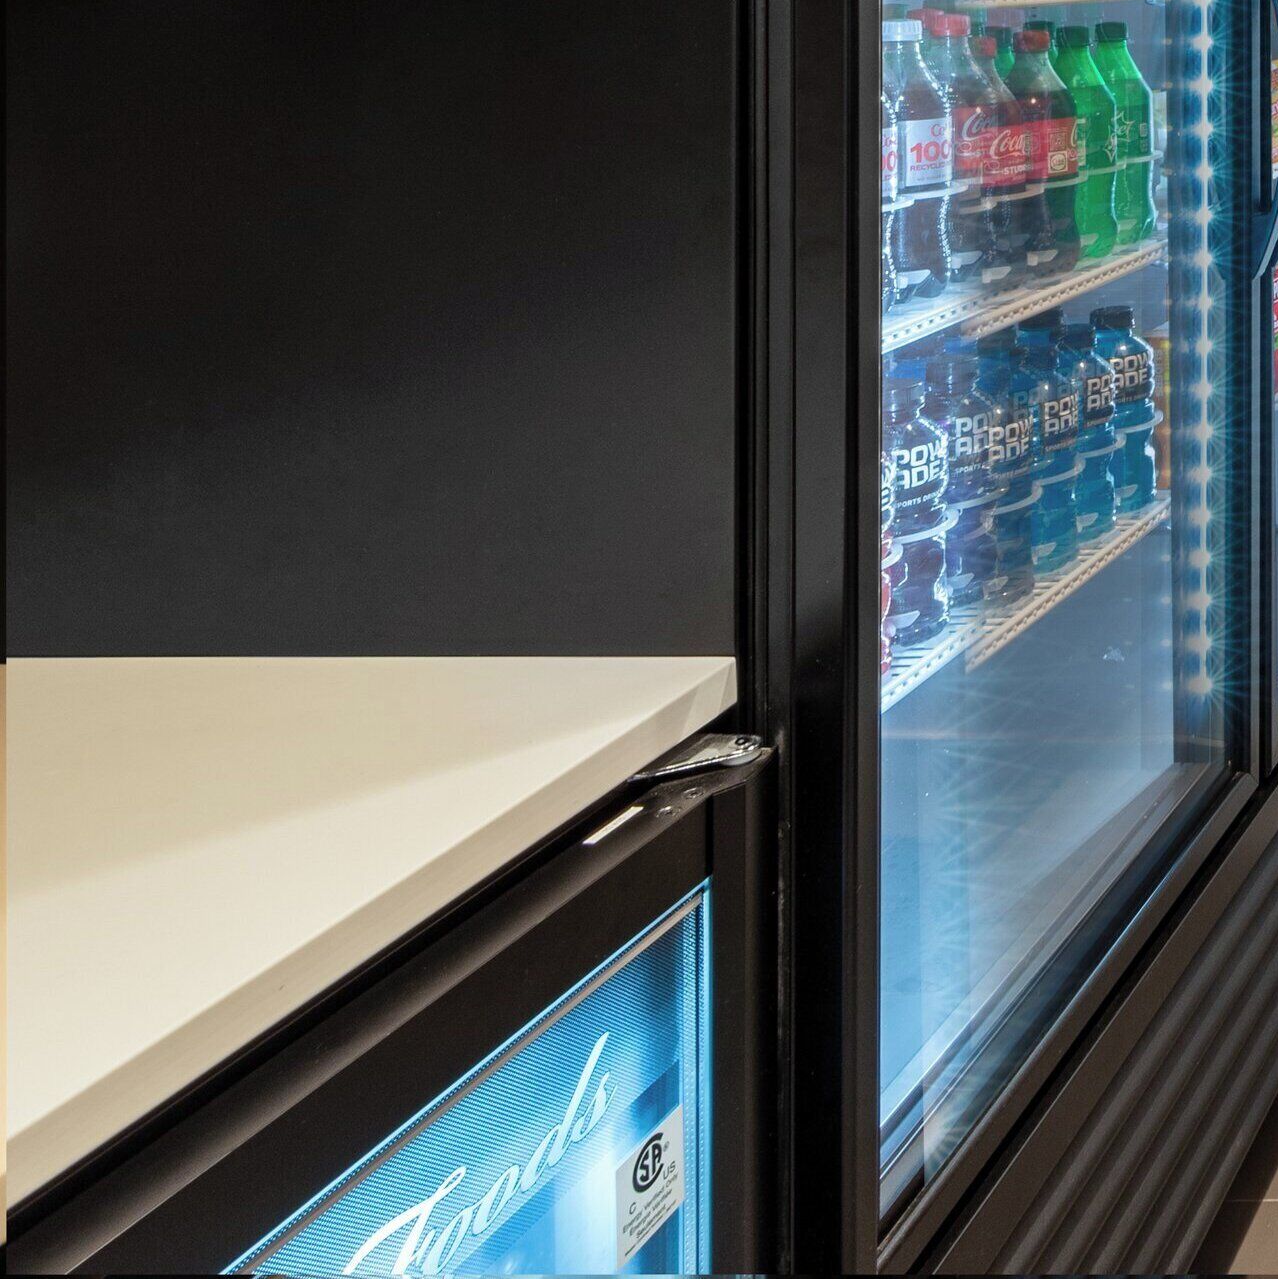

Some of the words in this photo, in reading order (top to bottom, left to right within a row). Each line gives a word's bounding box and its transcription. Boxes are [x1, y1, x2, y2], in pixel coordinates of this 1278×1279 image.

[910, 139, 952, 164] 100
[1109, 351, 1149, 370] POW
[1086, 373, 1111, 396] PO
[1112, 369, 1149, 388] ADE
[1086, 389, 1112, 413] AD
[988, 414, 1034, 447] POW
[891, 440, 944, 467] POW
[988, 437, 1031, 466] ADE
[896, 459, 942, 490] ADE
[662, 1160, 676, 1181] US
[665, 1172, 679, 1188] Only
